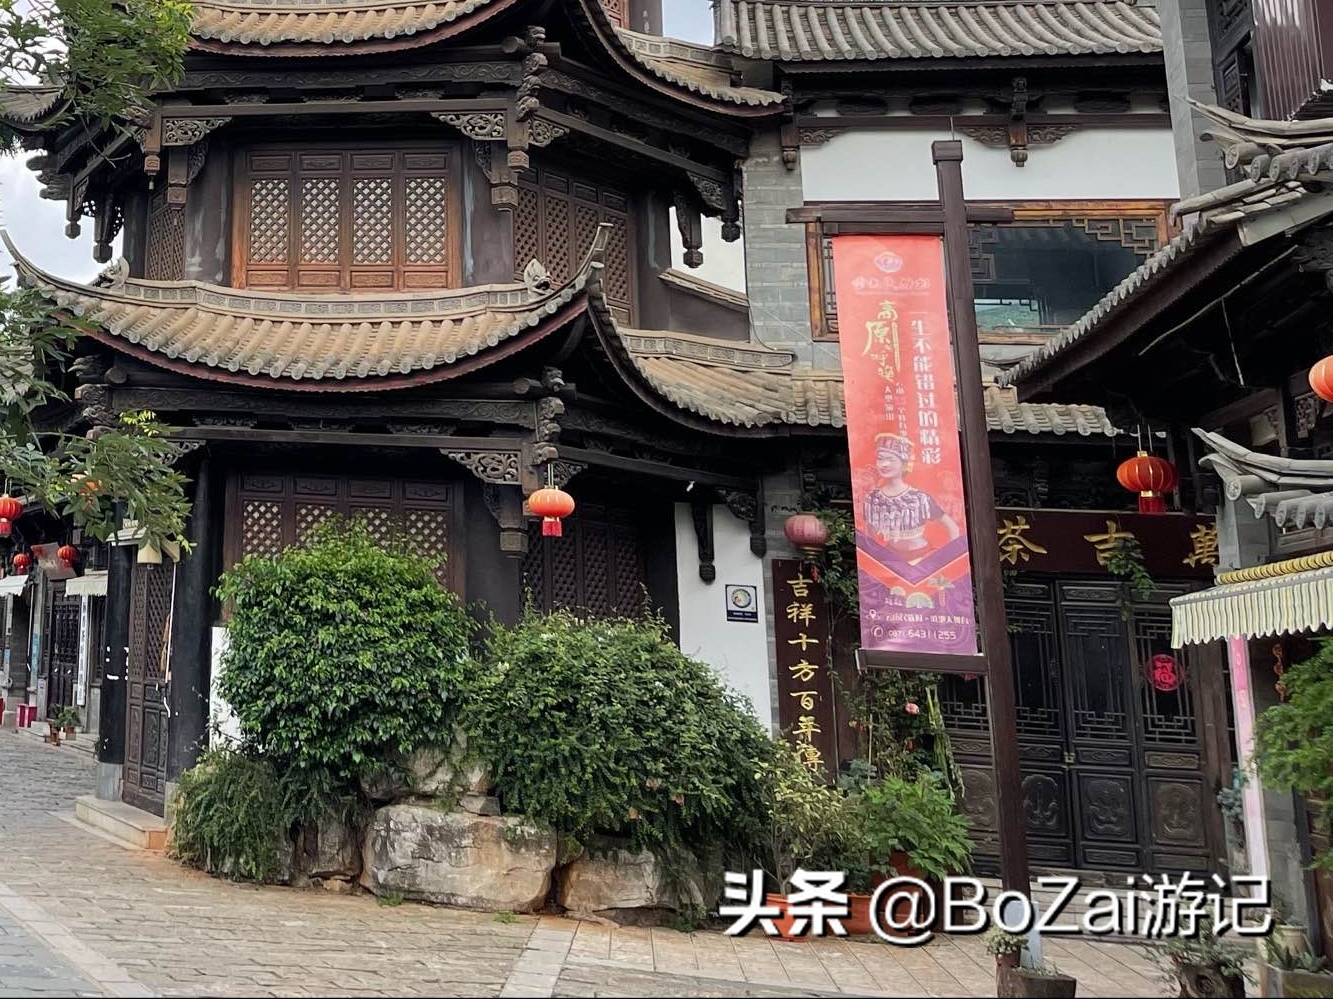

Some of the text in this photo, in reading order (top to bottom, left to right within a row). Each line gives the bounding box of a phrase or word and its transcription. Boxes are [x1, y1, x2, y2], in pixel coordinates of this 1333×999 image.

[908, 311, 942, 465] 一生不能错过的精彩
